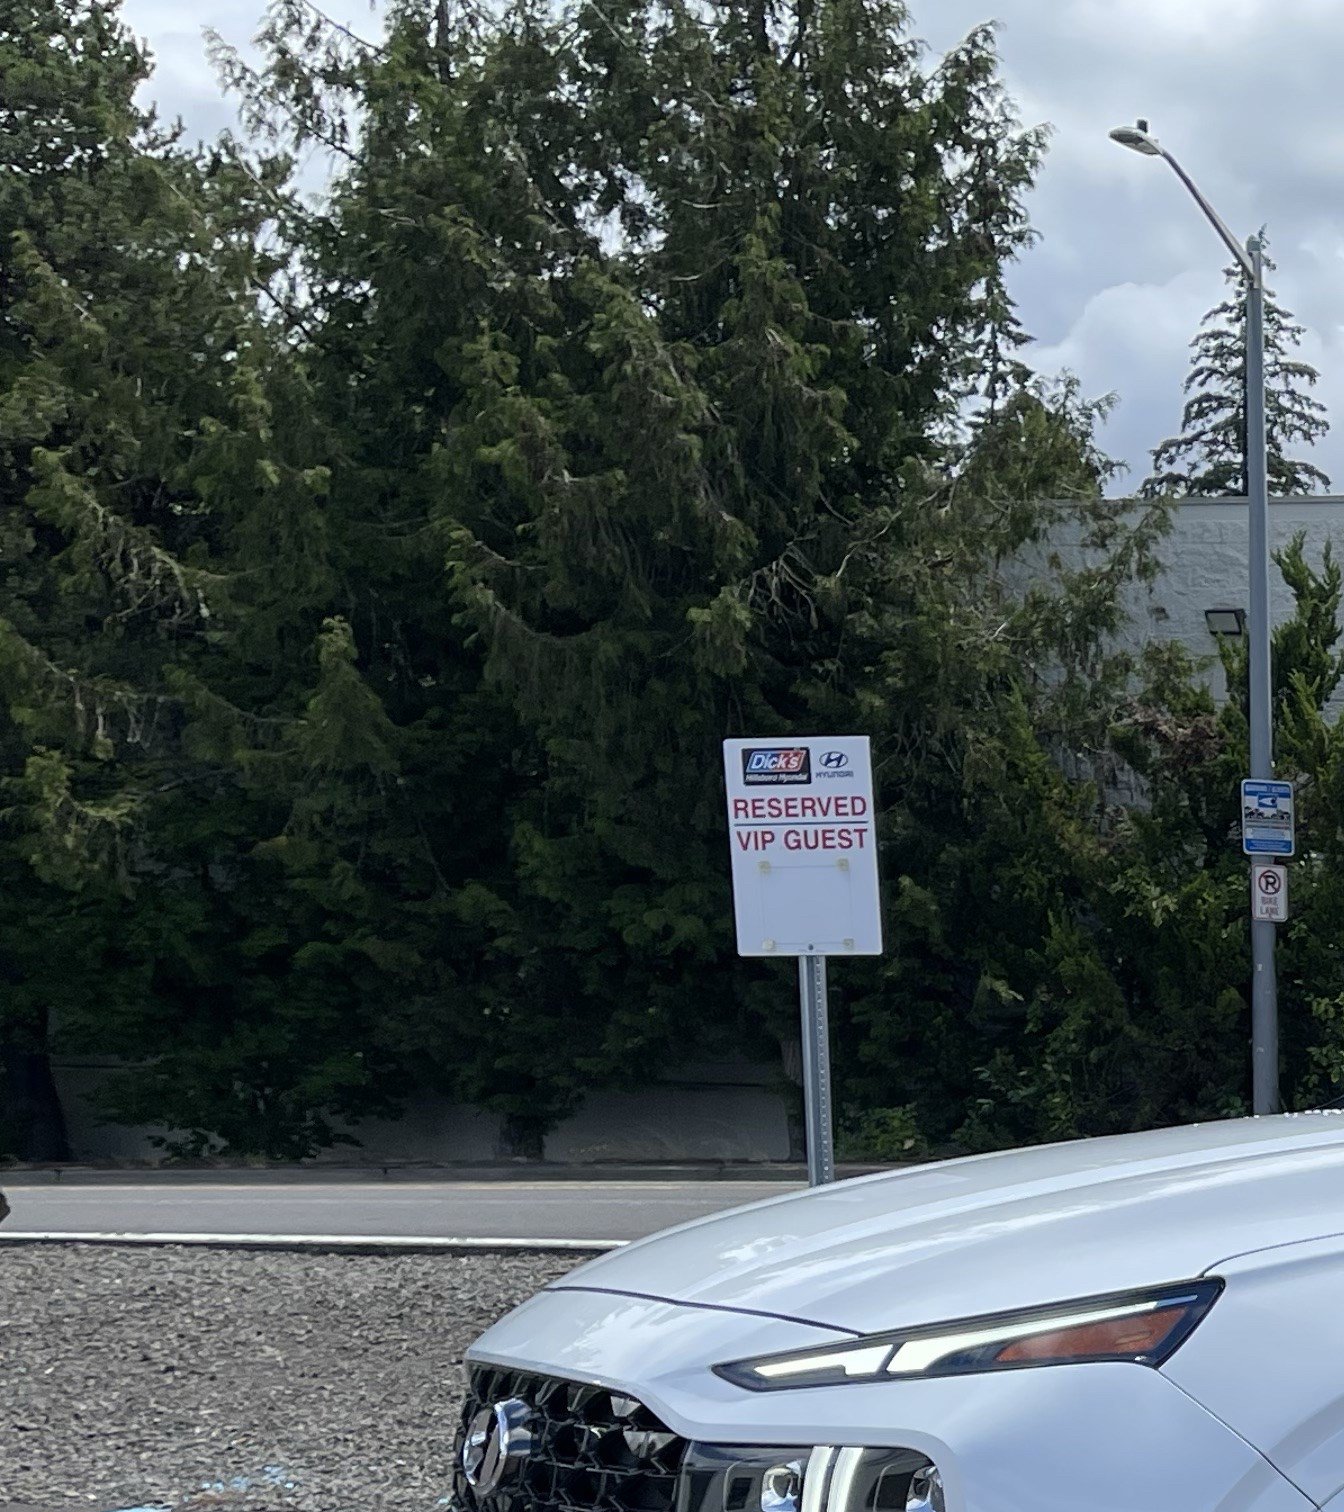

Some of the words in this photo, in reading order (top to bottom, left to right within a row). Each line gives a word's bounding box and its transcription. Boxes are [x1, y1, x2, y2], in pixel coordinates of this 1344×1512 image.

[734, 796, 867, 819] RESERVED
[737, 830, 775, 851] VIP
[784, 828, 868, 850] GUEST
